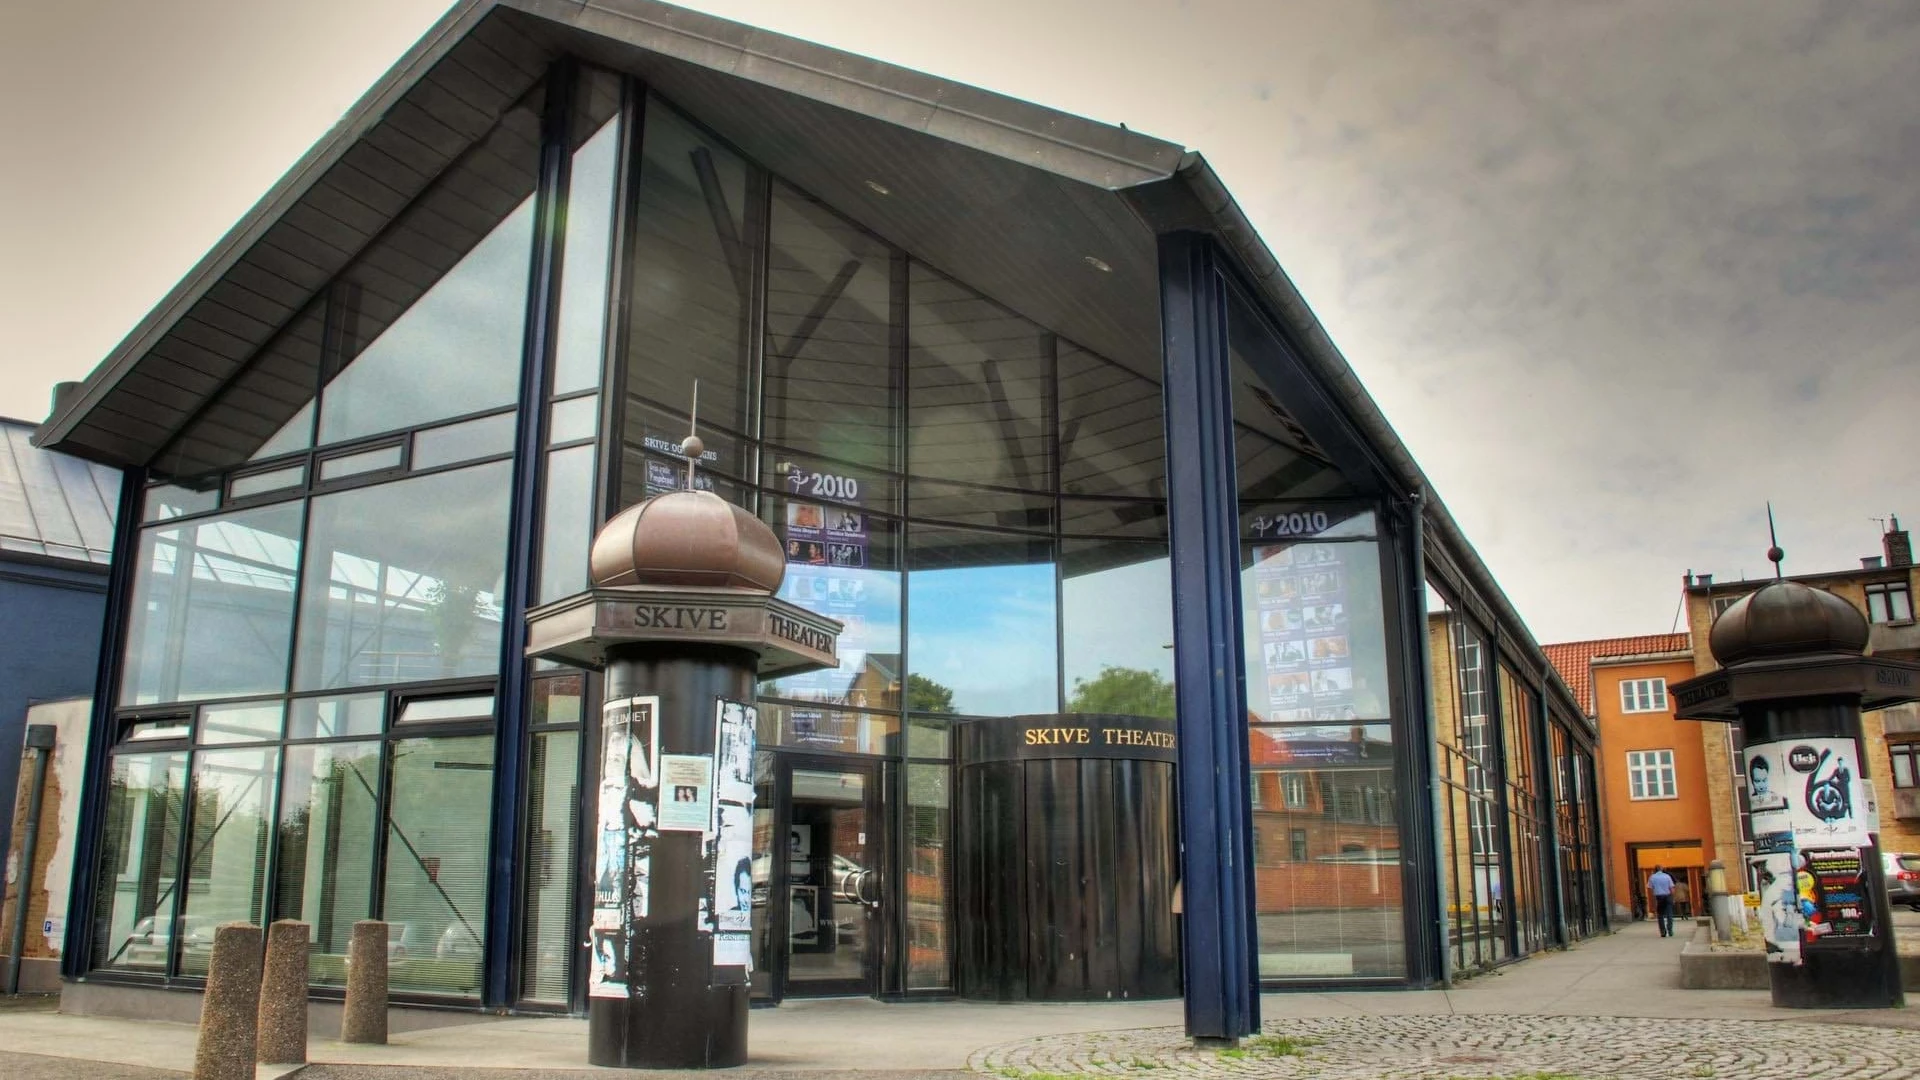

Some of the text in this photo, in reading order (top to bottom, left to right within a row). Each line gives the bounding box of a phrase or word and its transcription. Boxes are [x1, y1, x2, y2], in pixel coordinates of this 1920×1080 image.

[645, 437, 669, 451] SKIVE
[812, 472, 858, 499] 2010
[1276, 510, 1328, 536] 2010
[634, 605, 832, 654] SKIVE THEATER
[1025, 728, 1176, 749] SKIVE THEATER
